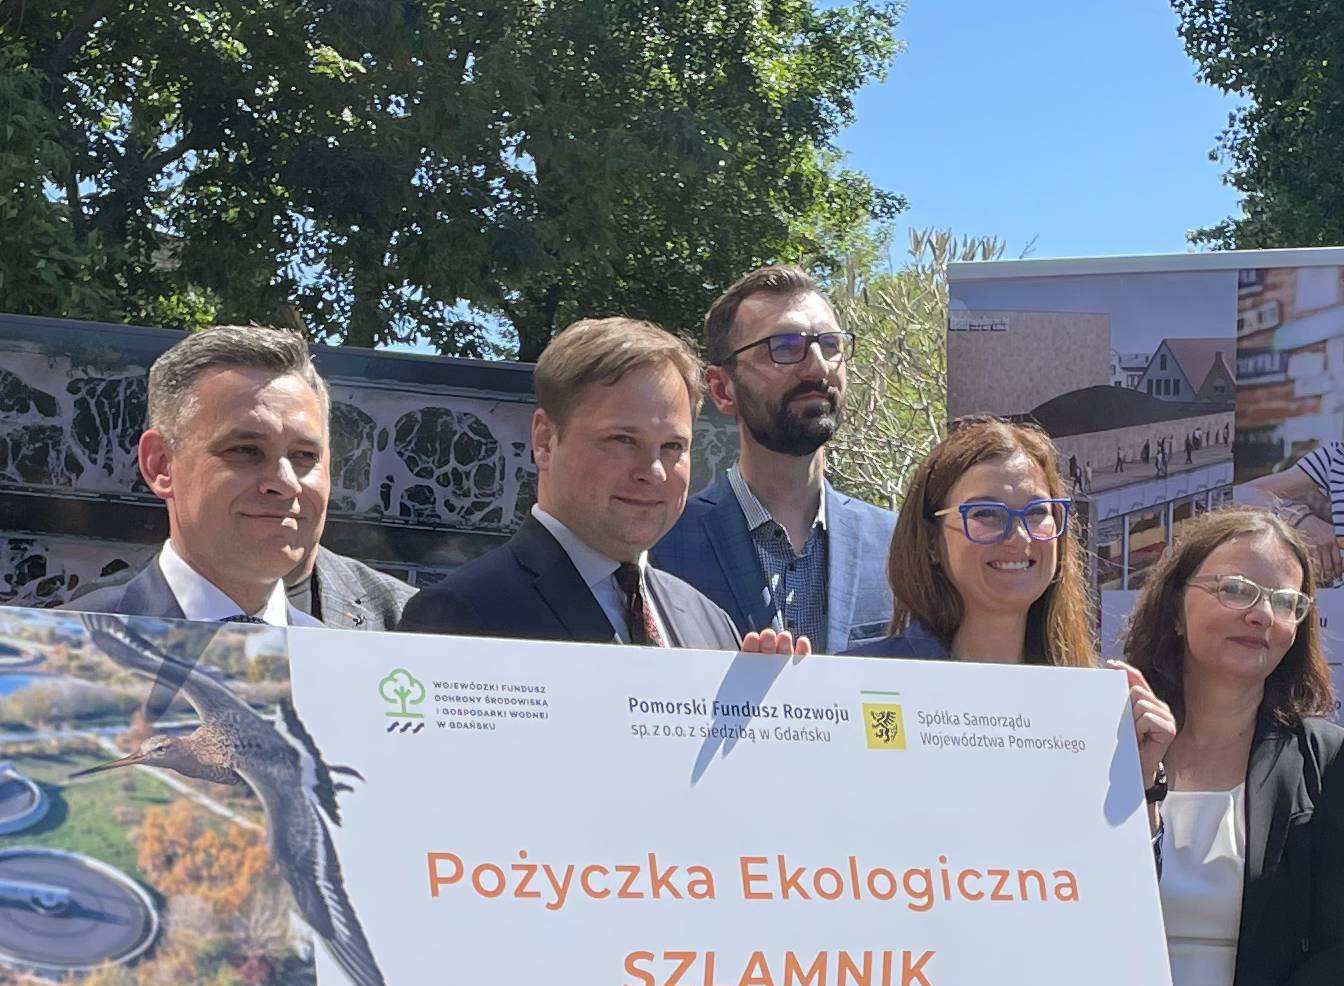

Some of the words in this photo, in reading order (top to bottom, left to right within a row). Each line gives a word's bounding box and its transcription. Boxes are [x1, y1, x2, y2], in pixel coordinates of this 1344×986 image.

[432, 681, 499, 691] WOJEWÓDZKI
[501, 685, 546, 694] FUNDUSZ
[434, 694, 482, 704] OCHRONY
[485, 694, 549, 706] ŚRODOWISKA
[442, 708, 507, 718] GOSPODARKI
[509, 711, 549, 719] WODNEJ
[628, 697, 707, 716] Pomorski
[712, 700, 779, 719] Fundusz
[783, 703, 850, 724] Rozwoju
[449, 720, 496, 730] GDAŃSKU
[917, 710, 960, 727] Spółka
[963, 713, 1031, 731] Samorządu
[631, 724, 651, 739] sp.
[653, 725, 660, 736] z
[689, 727, 696, 738] z
[700, 725, 756, 743] siedzibą
[759, 729, 770, 740] w
[774, 727, 831, 742] Gdańsku
[920, 732, 1005, 750] Województwa
[1009, 735, 1086, 754] Pomorskiego
[427, 849, 716, 911] Pożyczka
[739, 854, 1080, 912] Ekologiczna
